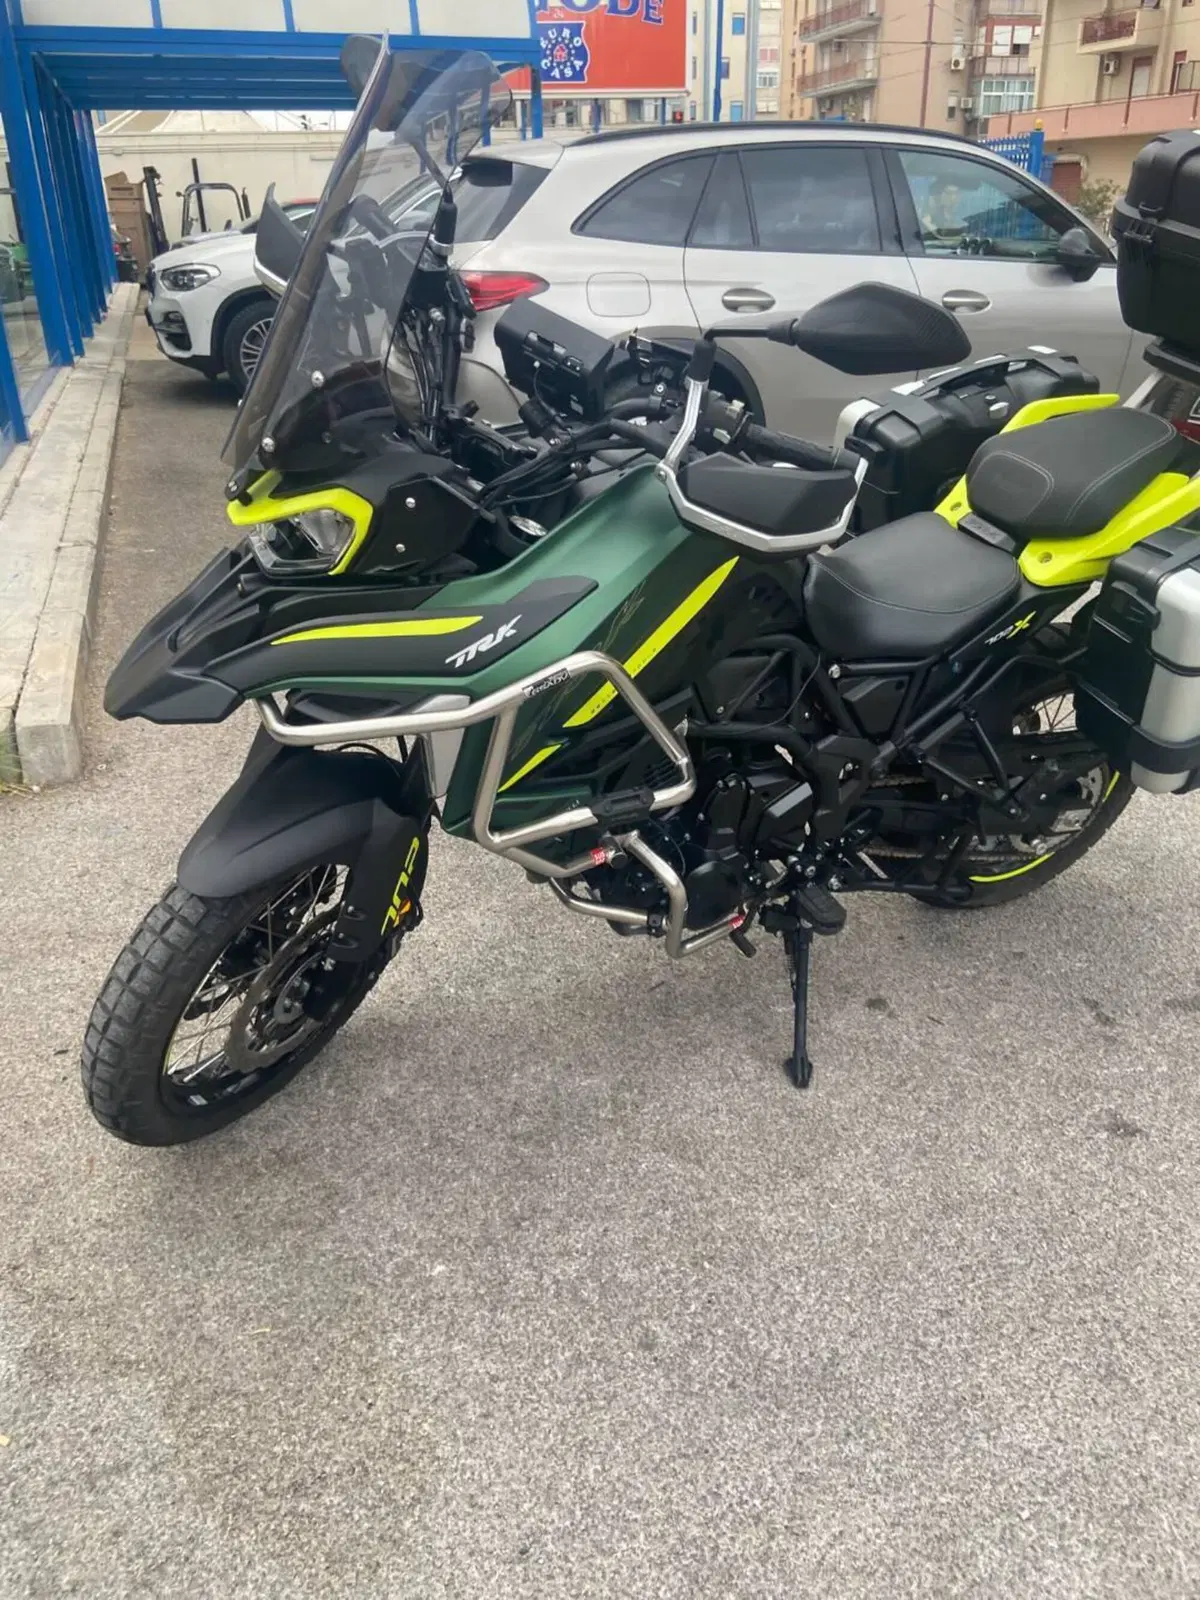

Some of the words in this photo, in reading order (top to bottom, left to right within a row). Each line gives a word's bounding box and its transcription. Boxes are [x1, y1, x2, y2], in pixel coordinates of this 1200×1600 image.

[540, 28, 582, 48] EURO
[540, 59, 583, 79] CASA
[445, 614, 523, 669] TRK
